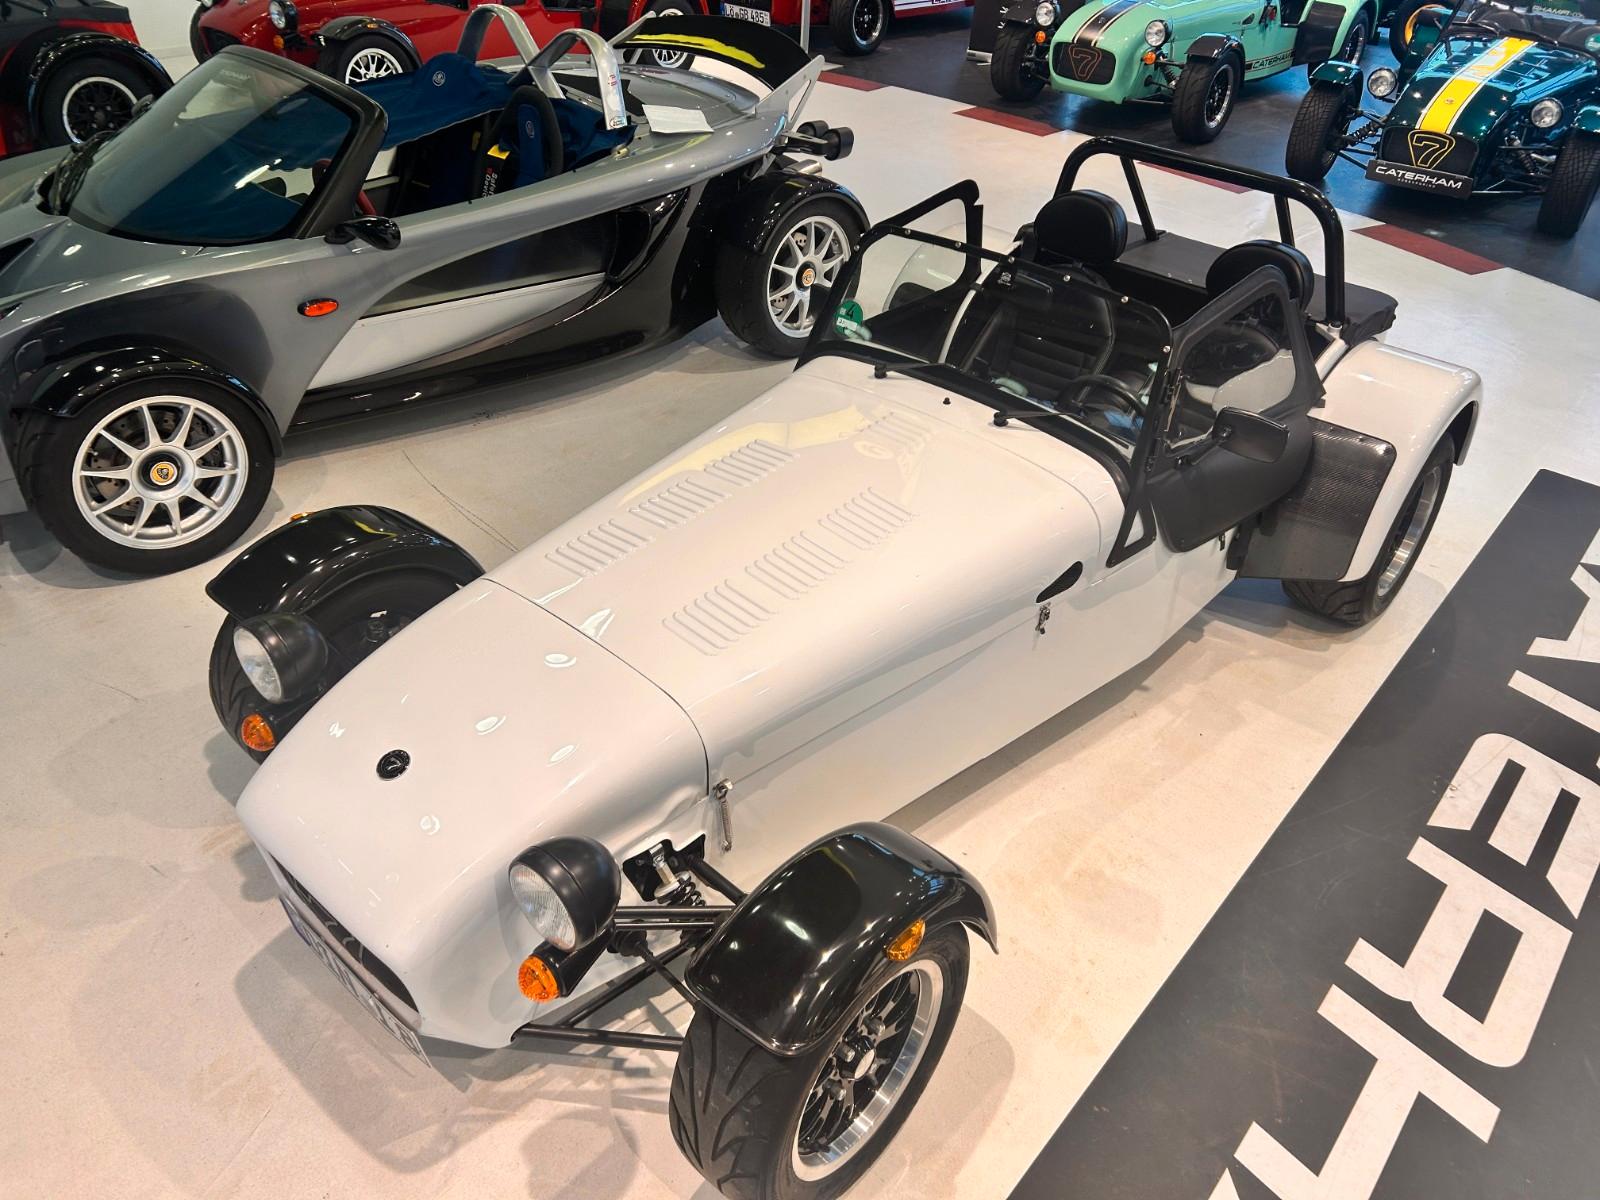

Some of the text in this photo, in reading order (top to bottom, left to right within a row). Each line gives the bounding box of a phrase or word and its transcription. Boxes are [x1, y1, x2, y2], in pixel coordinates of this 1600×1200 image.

[750, 11, 765, 24] 485
[1375, 165, 1463, 189] CATERHAM
[845, 303, 857, 320] 4
